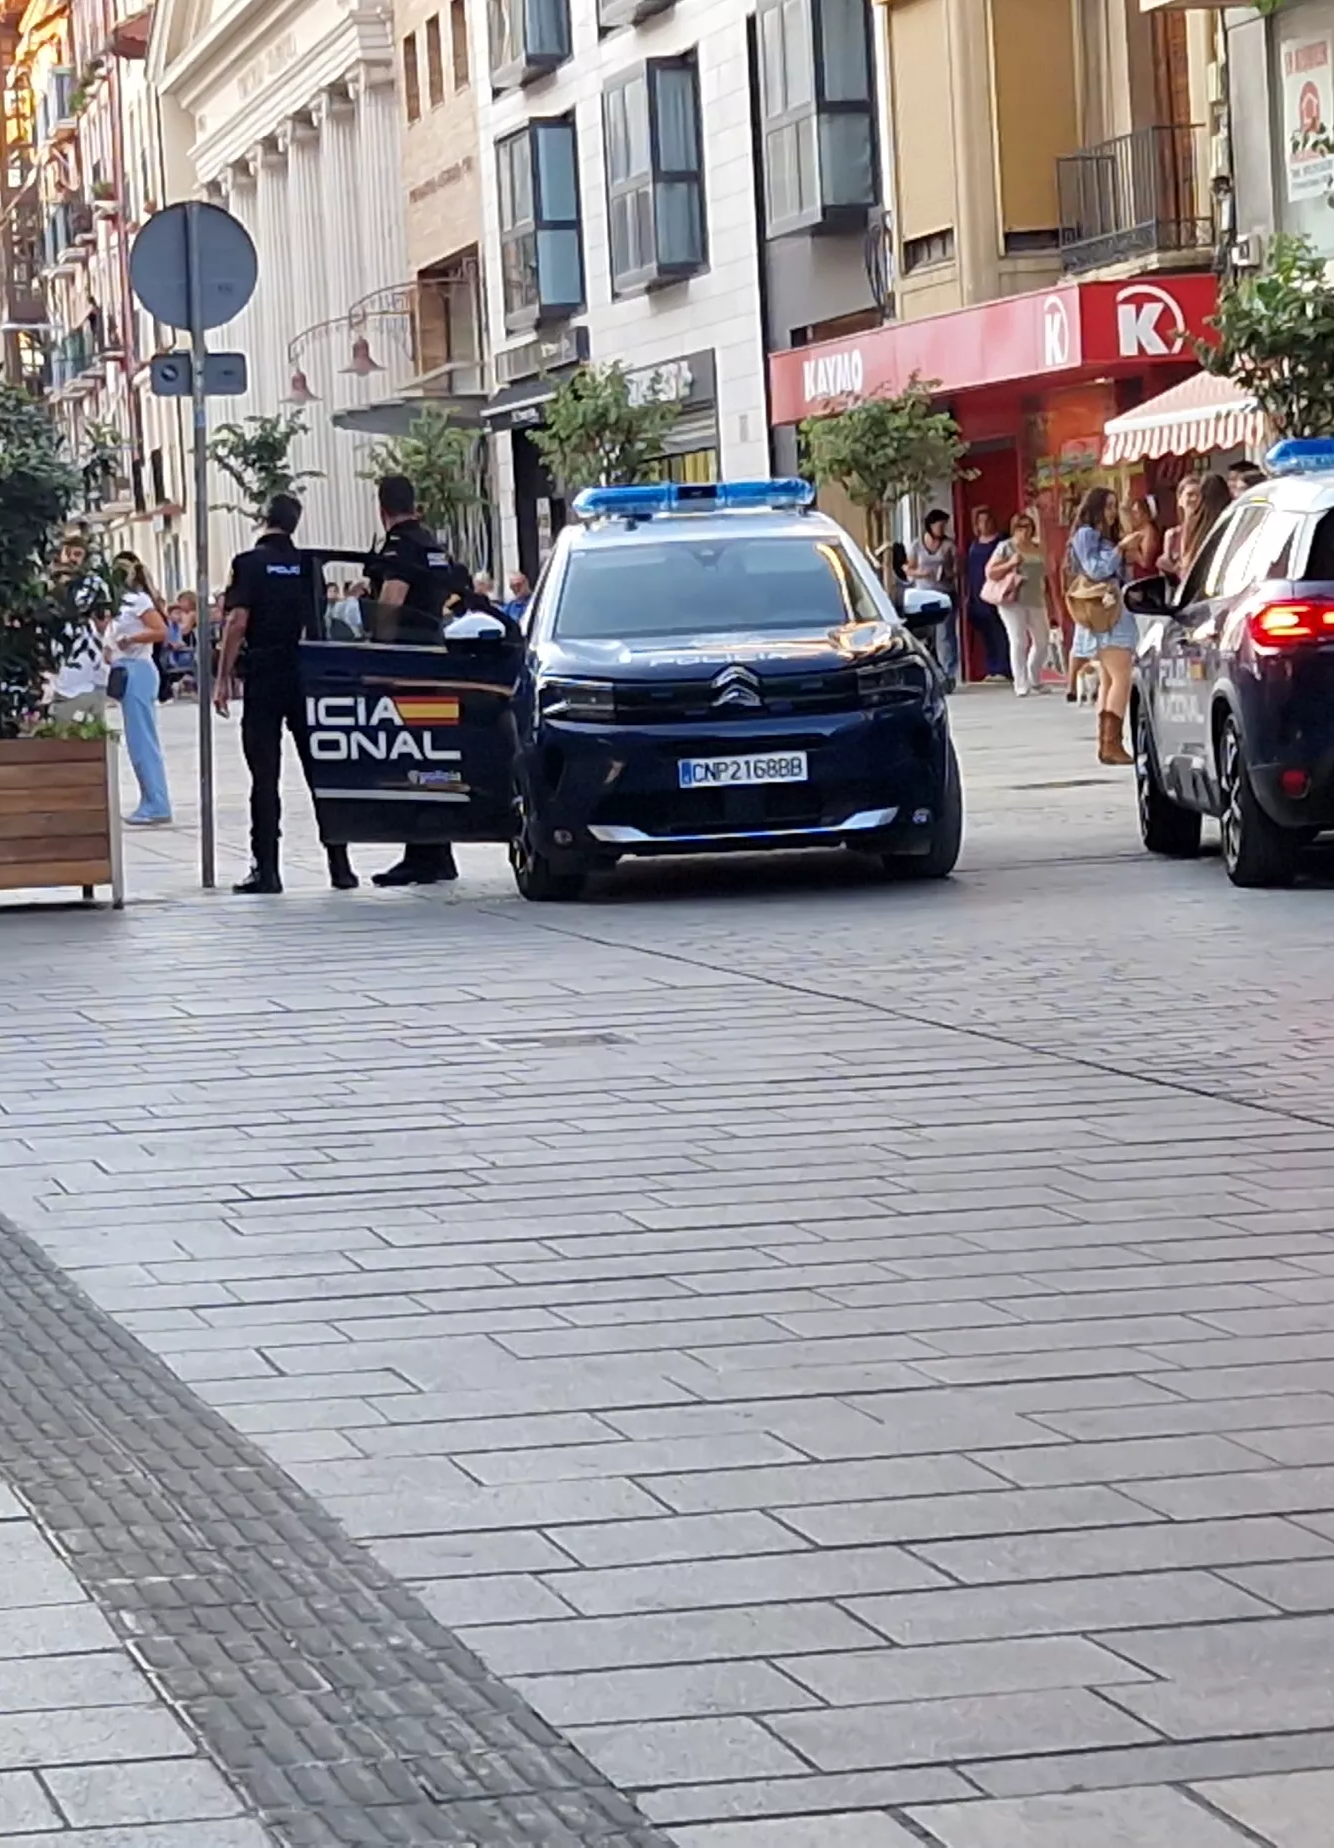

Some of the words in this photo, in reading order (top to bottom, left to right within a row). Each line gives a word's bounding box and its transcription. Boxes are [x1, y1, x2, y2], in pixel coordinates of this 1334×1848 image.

[803, 349, 864, 402] KAYMO
[309, 730, 462, 761] ONAL
[692, 756, 803, 783] CNP2168BB
